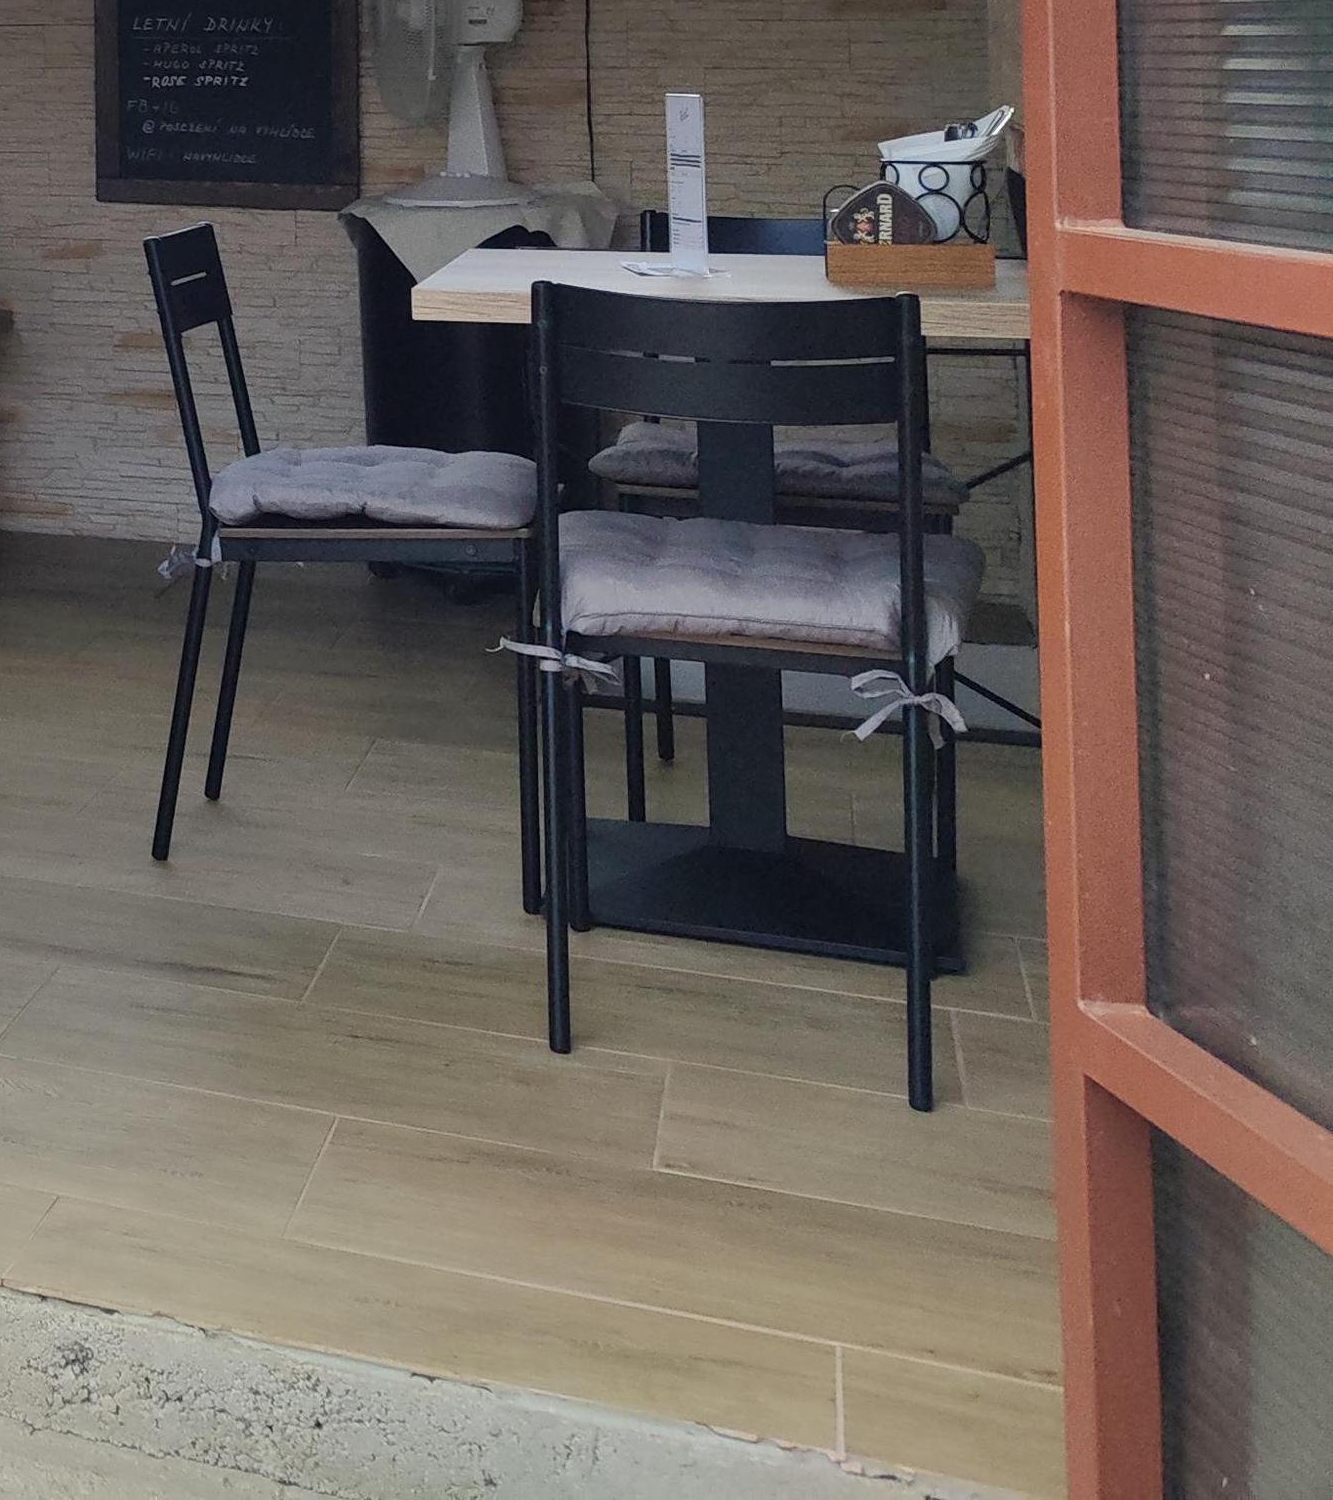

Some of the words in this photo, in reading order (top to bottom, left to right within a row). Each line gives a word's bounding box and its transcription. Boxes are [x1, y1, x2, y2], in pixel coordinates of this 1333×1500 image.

[132, 12, 193, 32] LETNÍ
[203, 15, 274, 34] DRINKY
[194, 75, 250, 88] SPRITZ
